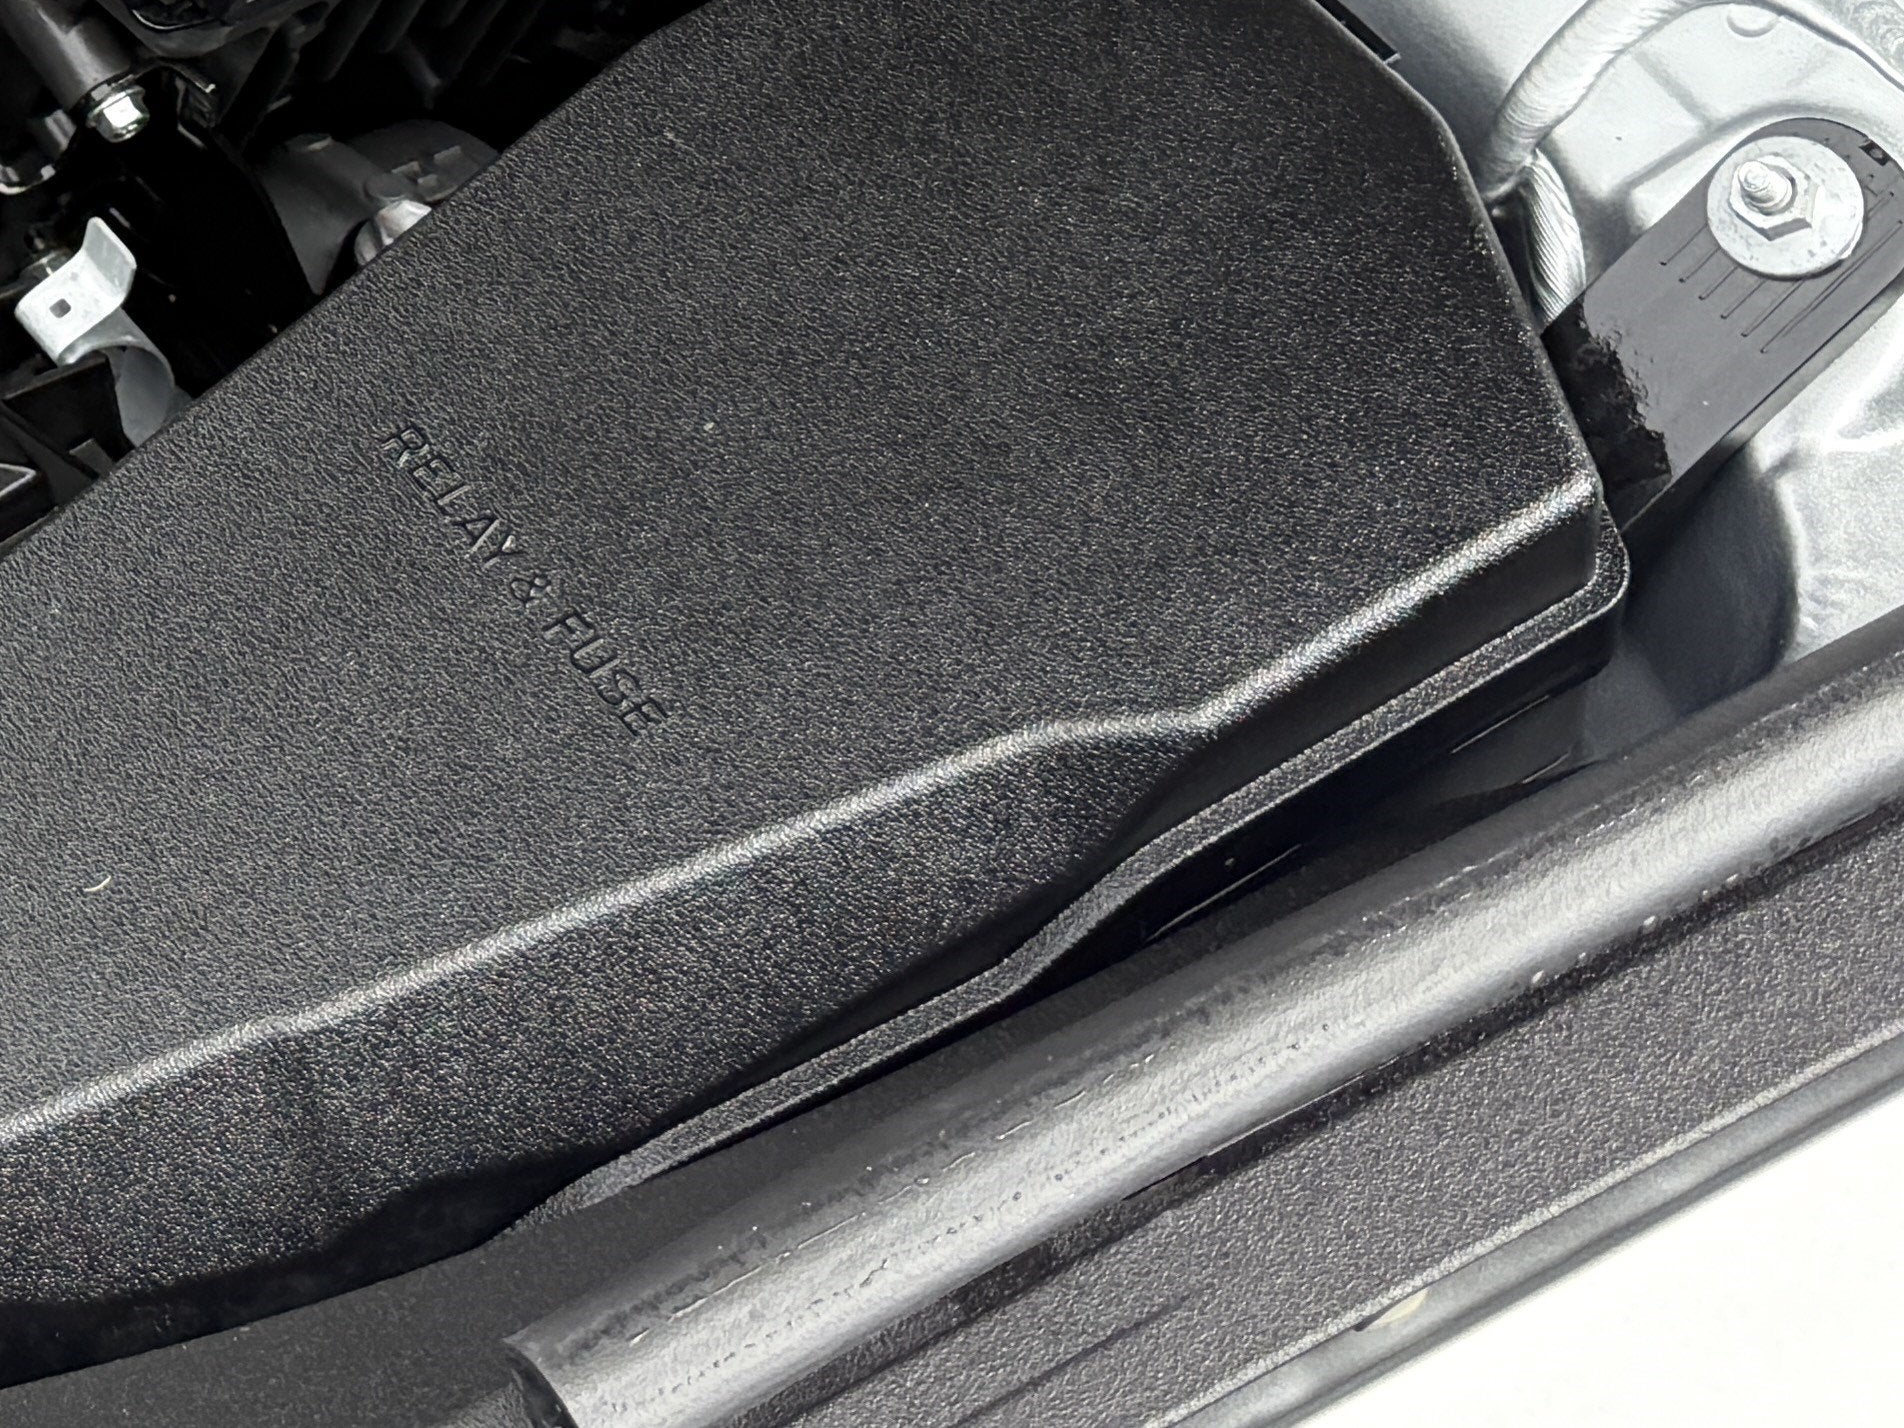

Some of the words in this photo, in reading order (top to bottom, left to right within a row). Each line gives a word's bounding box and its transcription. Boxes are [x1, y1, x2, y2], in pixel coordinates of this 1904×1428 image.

[381, 423, 527, 572] RELAY
[508, 572, 553, 610] &
[542, 606, 670, 738] FUSE
